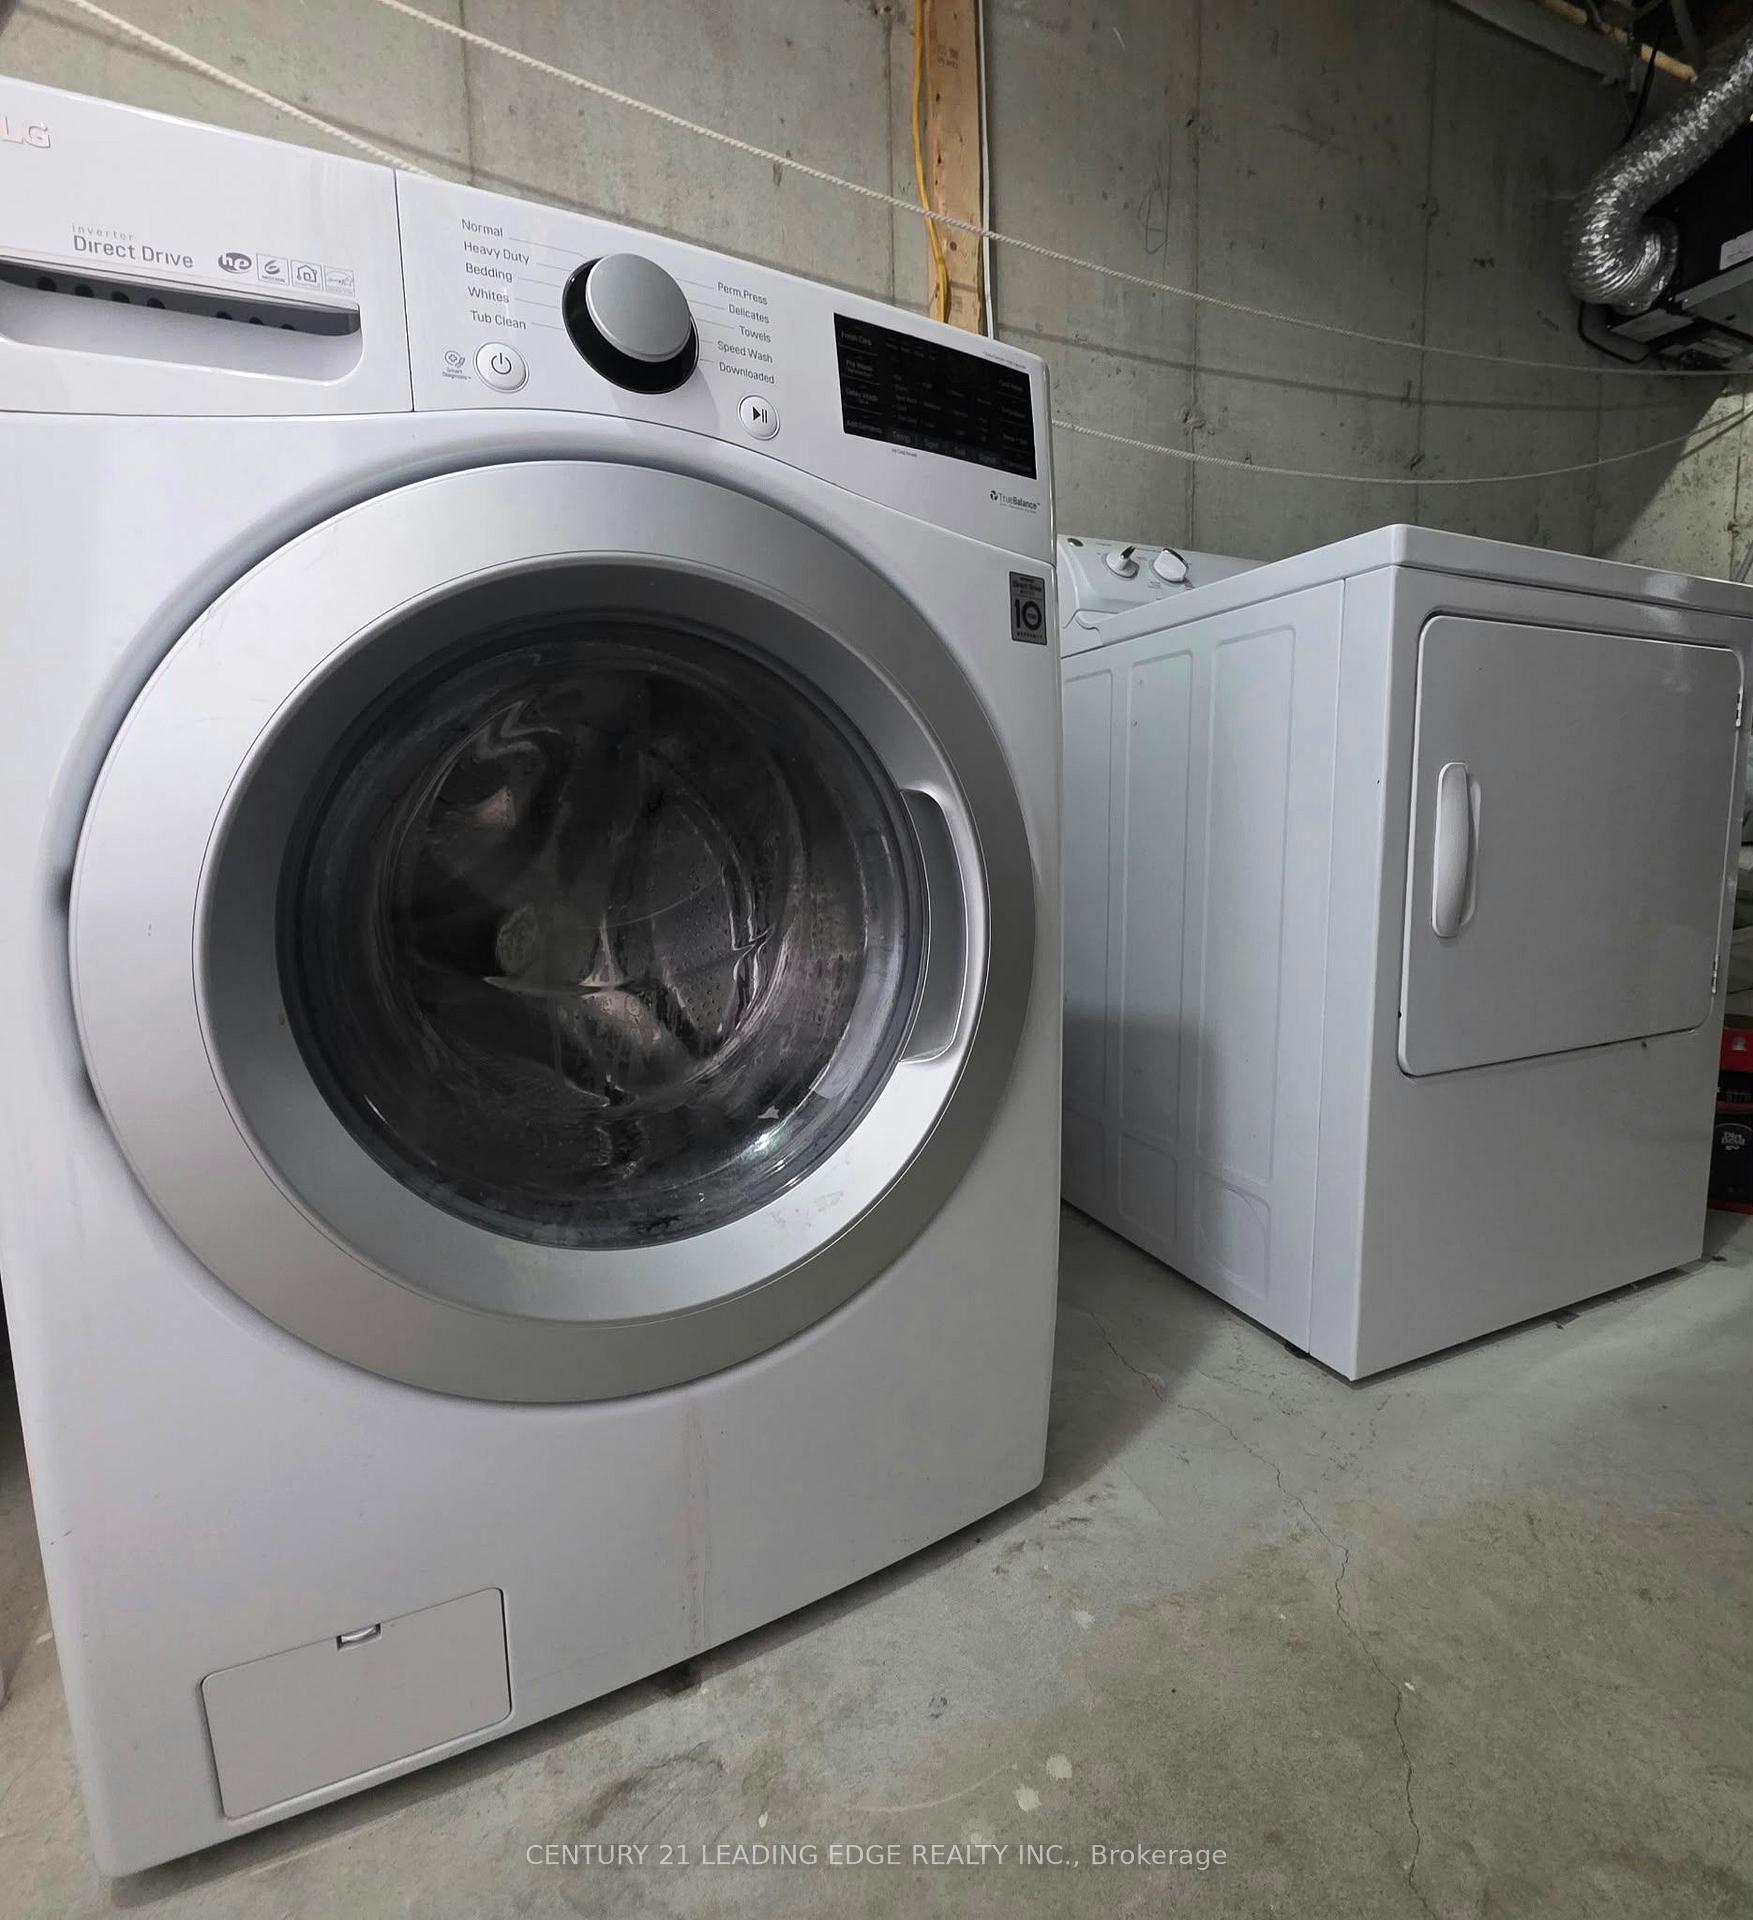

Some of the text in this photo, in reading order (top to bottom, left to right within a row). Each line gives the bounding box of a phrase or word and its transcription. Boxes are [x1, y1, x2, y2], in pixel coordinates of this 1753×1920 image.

[0, 115, 51, 149] LG
[72, 223, 134, 241] Inverter
[461, 218, 503, 237] Normal
[73, 234, 194, 269] Direct Drive
[463, 240, 530, 265] Heavy Duty
[465, 262, 513, 283] Bedding
[468, 285, 510, 304] Whites
[470, 310, 527, 330] Tub Clean
[728, 303, 770, 324] Delicates
[739, 325, 771, 343] Towels
[717, 340, 773, 364] Speed Wash
[719, 361, 775, 385] Downloaded
[1014, 599, 1042, 630] 10
